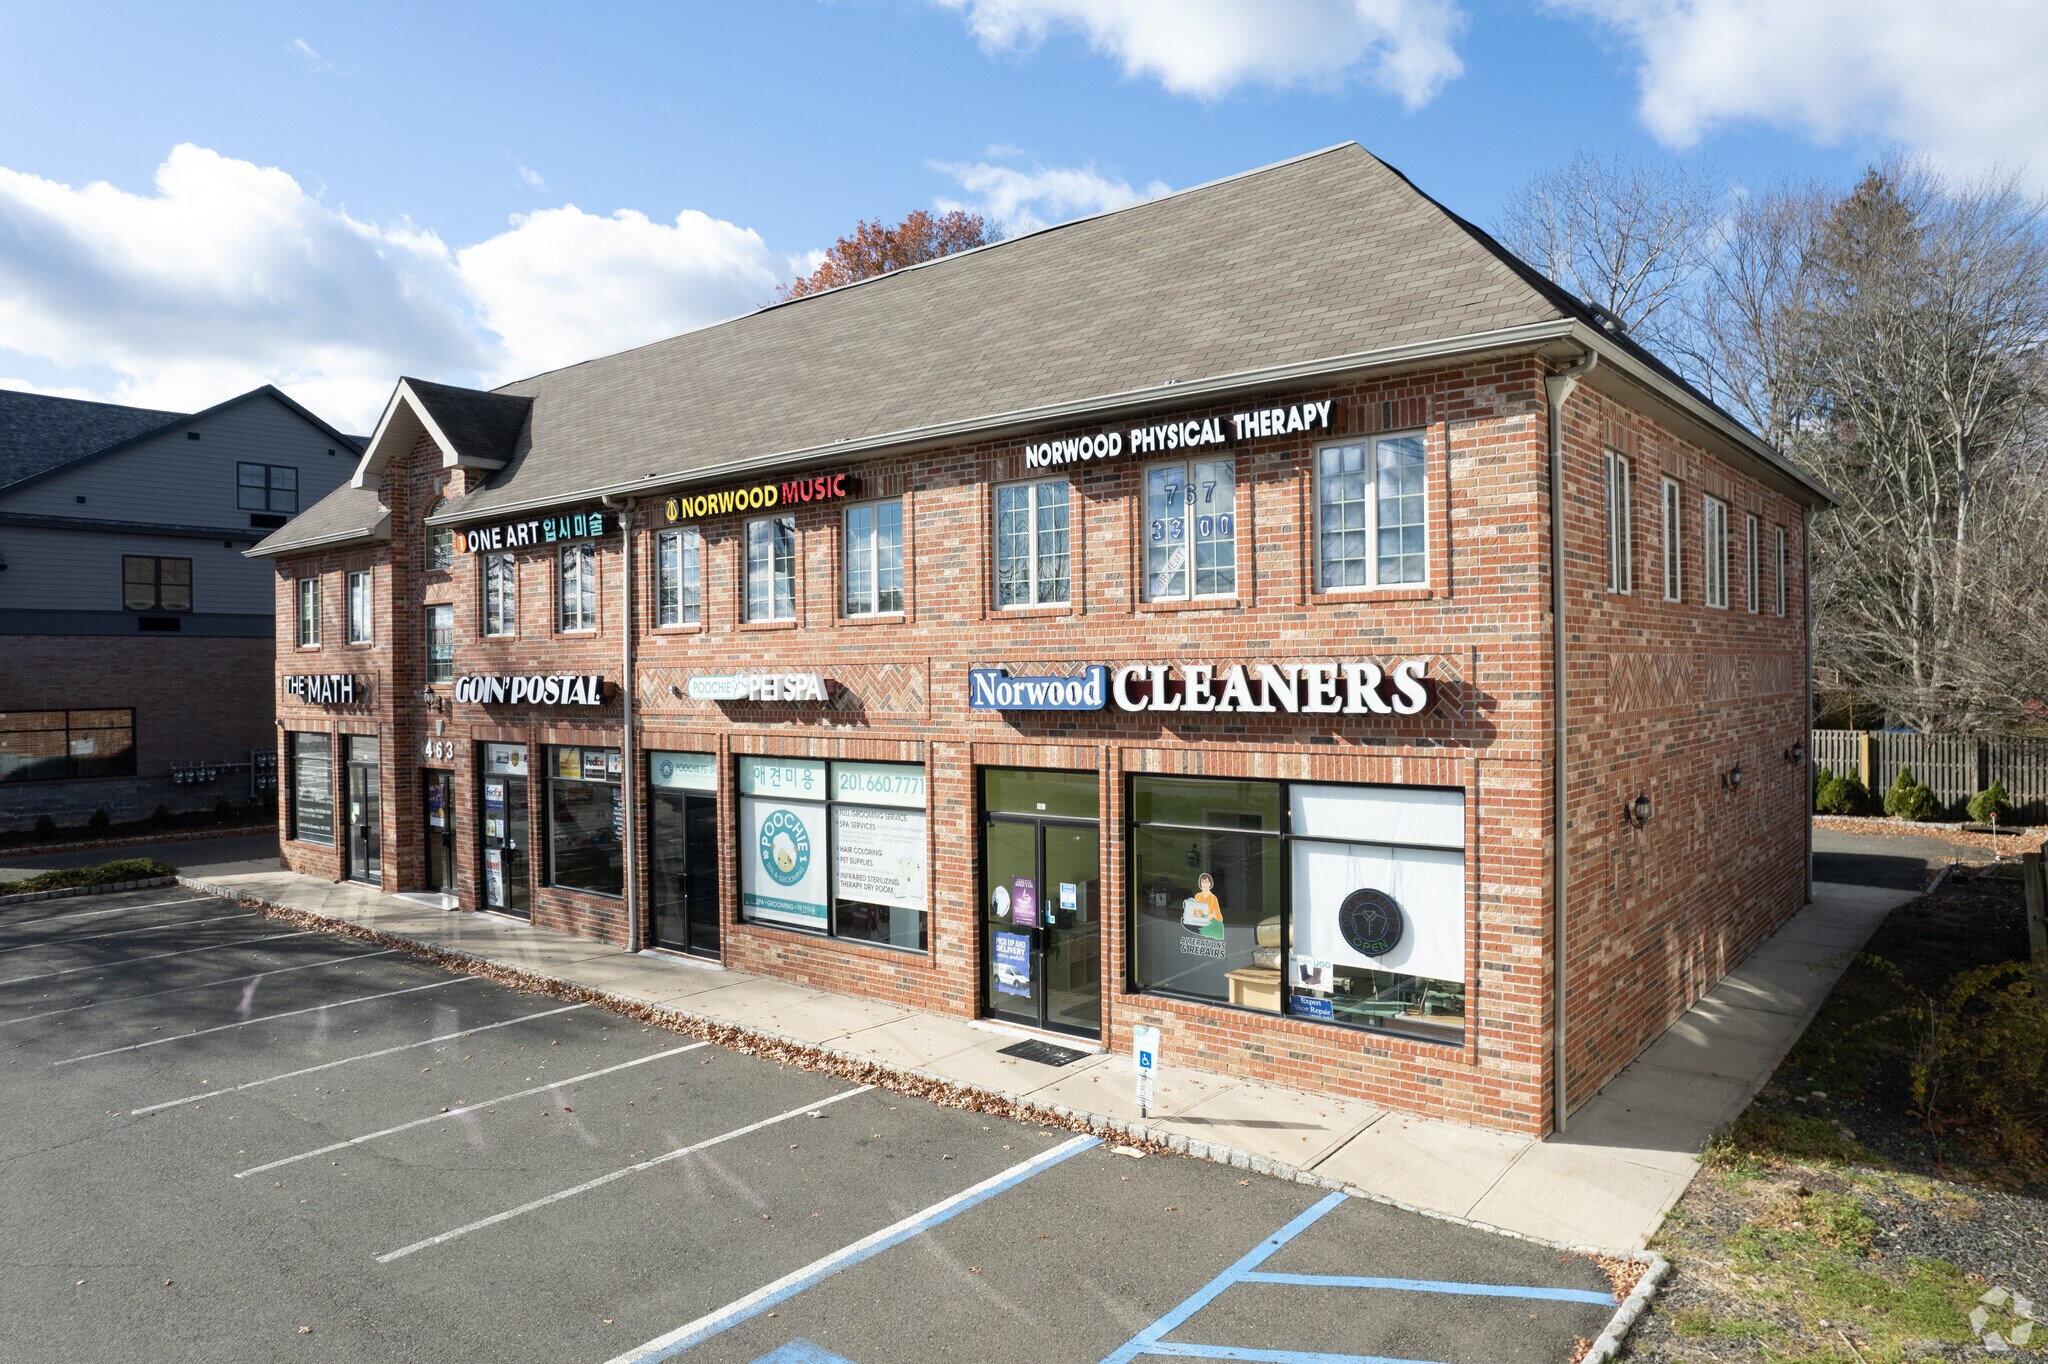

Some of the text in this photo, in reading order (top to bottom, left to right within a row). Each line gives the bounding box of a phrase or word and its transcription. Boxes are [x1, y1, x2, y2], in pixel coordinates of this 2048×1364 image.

[1026, 400, 1331, 468] NORWOOD PHYSICAL THERAPY
[682, 474, 846, 518] NORWOOD MUSIC
[1165, 481, 1216, 505] 767
[468, 527, 502, 552] ONE
[506, 521, 539, 547] ART
[543, 512, 603, 542] 입시미술
[1152, 513, 1232, 541] 3300
[285, 674, 353, 703] THE MATH
[511, 675, 600, 705] POSTAL
[693, 673, 824, 701] POOCHIE PET SPA
[973, 661, 1429, 714] Norwood CLEANERS
[425, 740, 454, 760] 463
[585, 756, 604, 766] FedEx
[676, 764, 700, 773] POOCHIE
[701, 765, 709, 774] PET
[754, 767, 814, 791] 애견미용
[840, 773, 925, 795] 201.660.7771
[486, 787, 501, 797] FedEx
[851, 811, 883, 820] GROOMING
[885, 814, 907, 822] SERVICE
[762, 812, 808, 852] POOCHIE
[851, 822, 876, 831] SERVICES
[853, 847, 883, 857] COLORING
[840, 856, 873, 866] PET SUPPLIES
[766, 862, 775, 875] SPA
[778, 866, 805, 883] GROOMING
[840, 873, 900, 886] INFRARED STERILIZING
[840, 880, 863, 889] THERAPY
[863, 883, 875, 891] DRY
[875, 885, 894, 894] ROOM
[755, 898, 765, 906] SPA
[766, 899, 793, 910] GROOMING
[1354, 893, 1397, 933] CLEANERS
[996, 938, 1026, 948] PICK UP AND
[996, 945, 1025, 955] DELIVERY
[1180, 937, 1226, 949] ALTERATIONS
[1353, 938, 1388, 952] OPEN
[1181, 945, 1226, 959] & REPAIRS
[1313, 960, 1331, 968] UGG
[1301, 997, 1321, 1006] Expert
[1310, 1006, 1331, 1015] Repair
